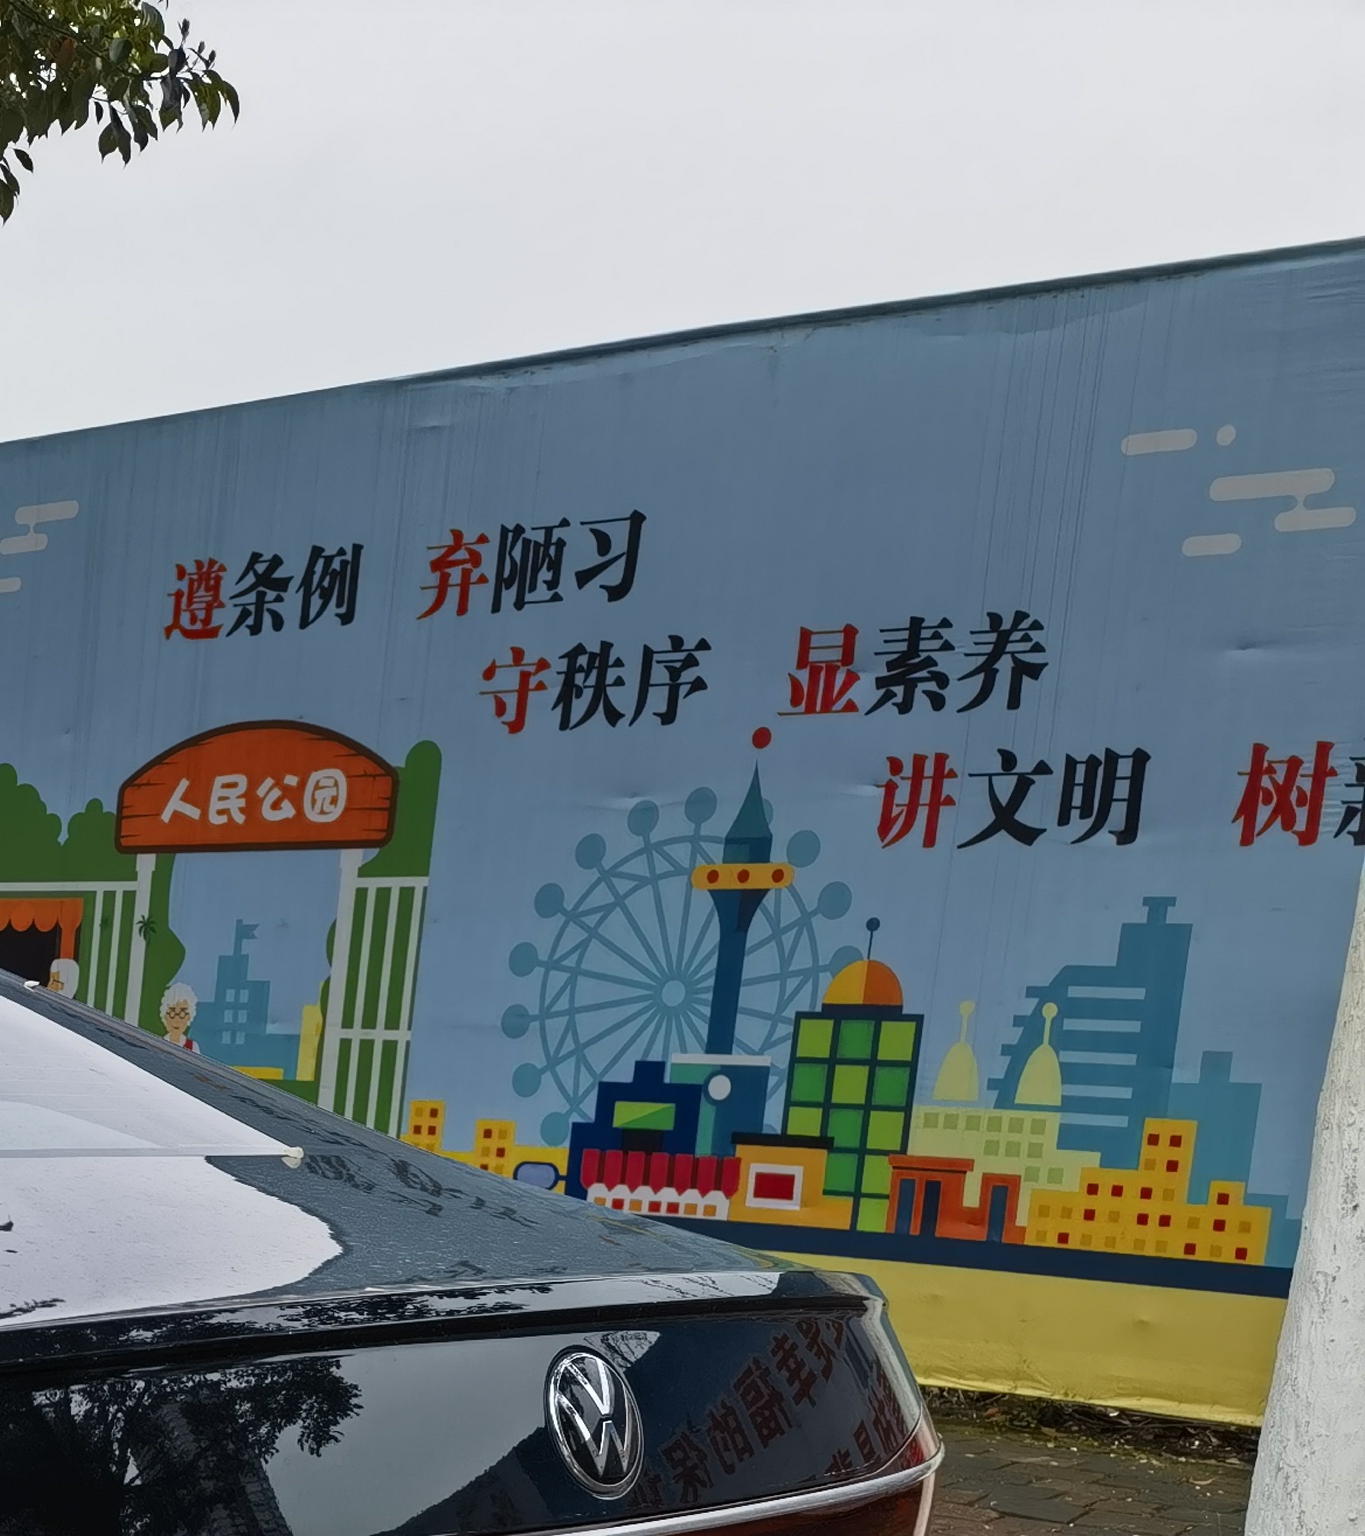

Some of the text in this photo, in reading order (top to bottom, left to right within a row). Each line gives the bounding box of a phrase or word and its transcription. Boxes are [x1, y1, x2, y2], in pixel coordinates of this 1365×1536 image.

[164, 509, 647, 640] 遵条例 弃陋习
[479, 610, 1049, 735] 守秩序 显素养
[161, 768, 348, 825] 人民公园
[875, 747, 1151, 850] 讲文明
